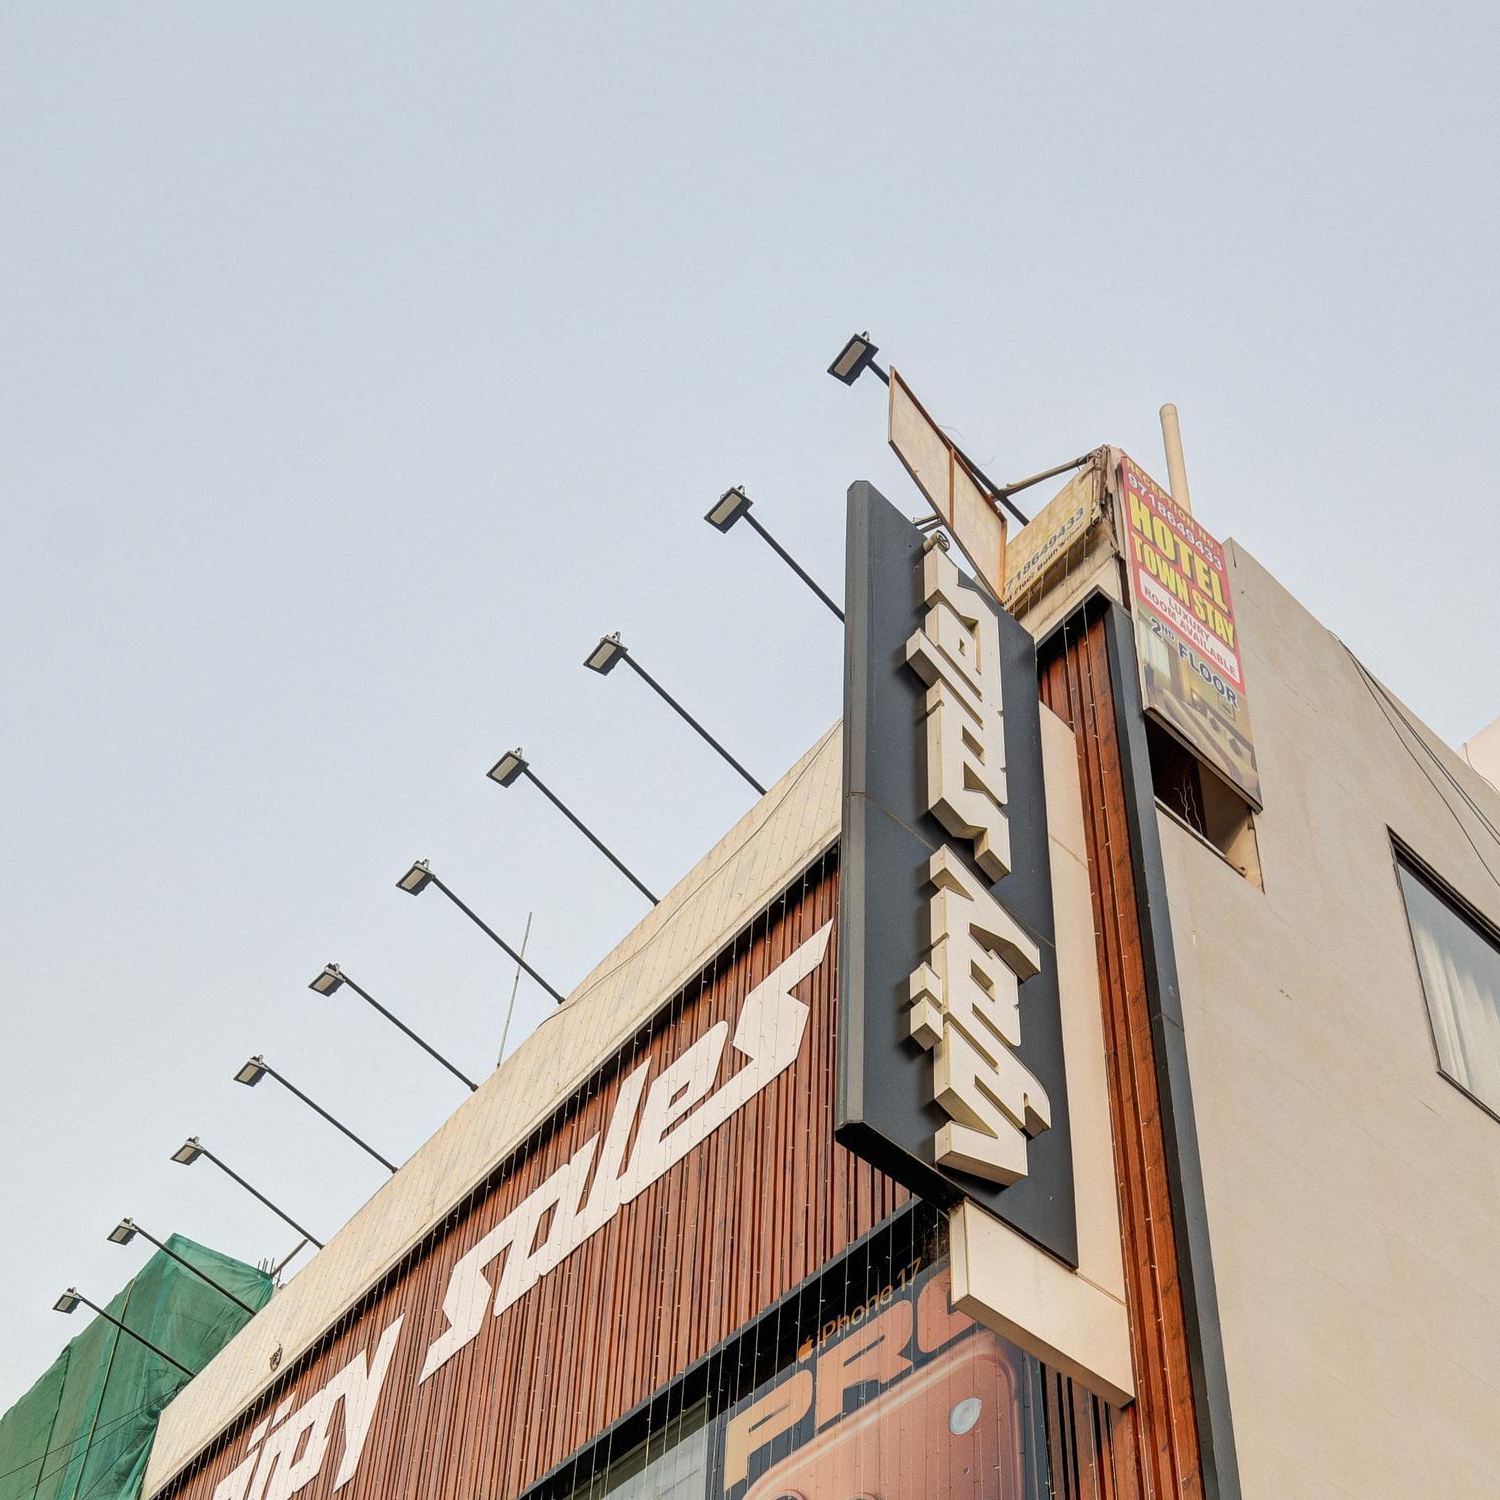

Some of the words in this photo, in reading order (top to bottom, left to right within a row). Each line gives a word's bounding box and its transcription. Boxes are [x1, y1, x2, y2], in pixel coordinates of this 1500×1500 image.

[1127, 458, 1195, 531] RECEPTION
[1127, 473, 1223, 572] 9718649433
[1129, 490, 1232, 617] HOTEL
[1131, 531, 1191, 607] TOWN
[1191, 588, 1236, 649] STAY
[1144, 584, 1177, 625] ROOM
[1179, 616, 1237, 678] AVAILABLE
[1150, 617, 1175, 641] 2ND
[1177, 641, 1240, 710] FLOOR
[1168, 596, 1210, 642] LUXURY
[418, 918, 834, 1386] sales
[816, 1281, 893, 1357] iPhone
[897, 1256, 922, 1299] 17
